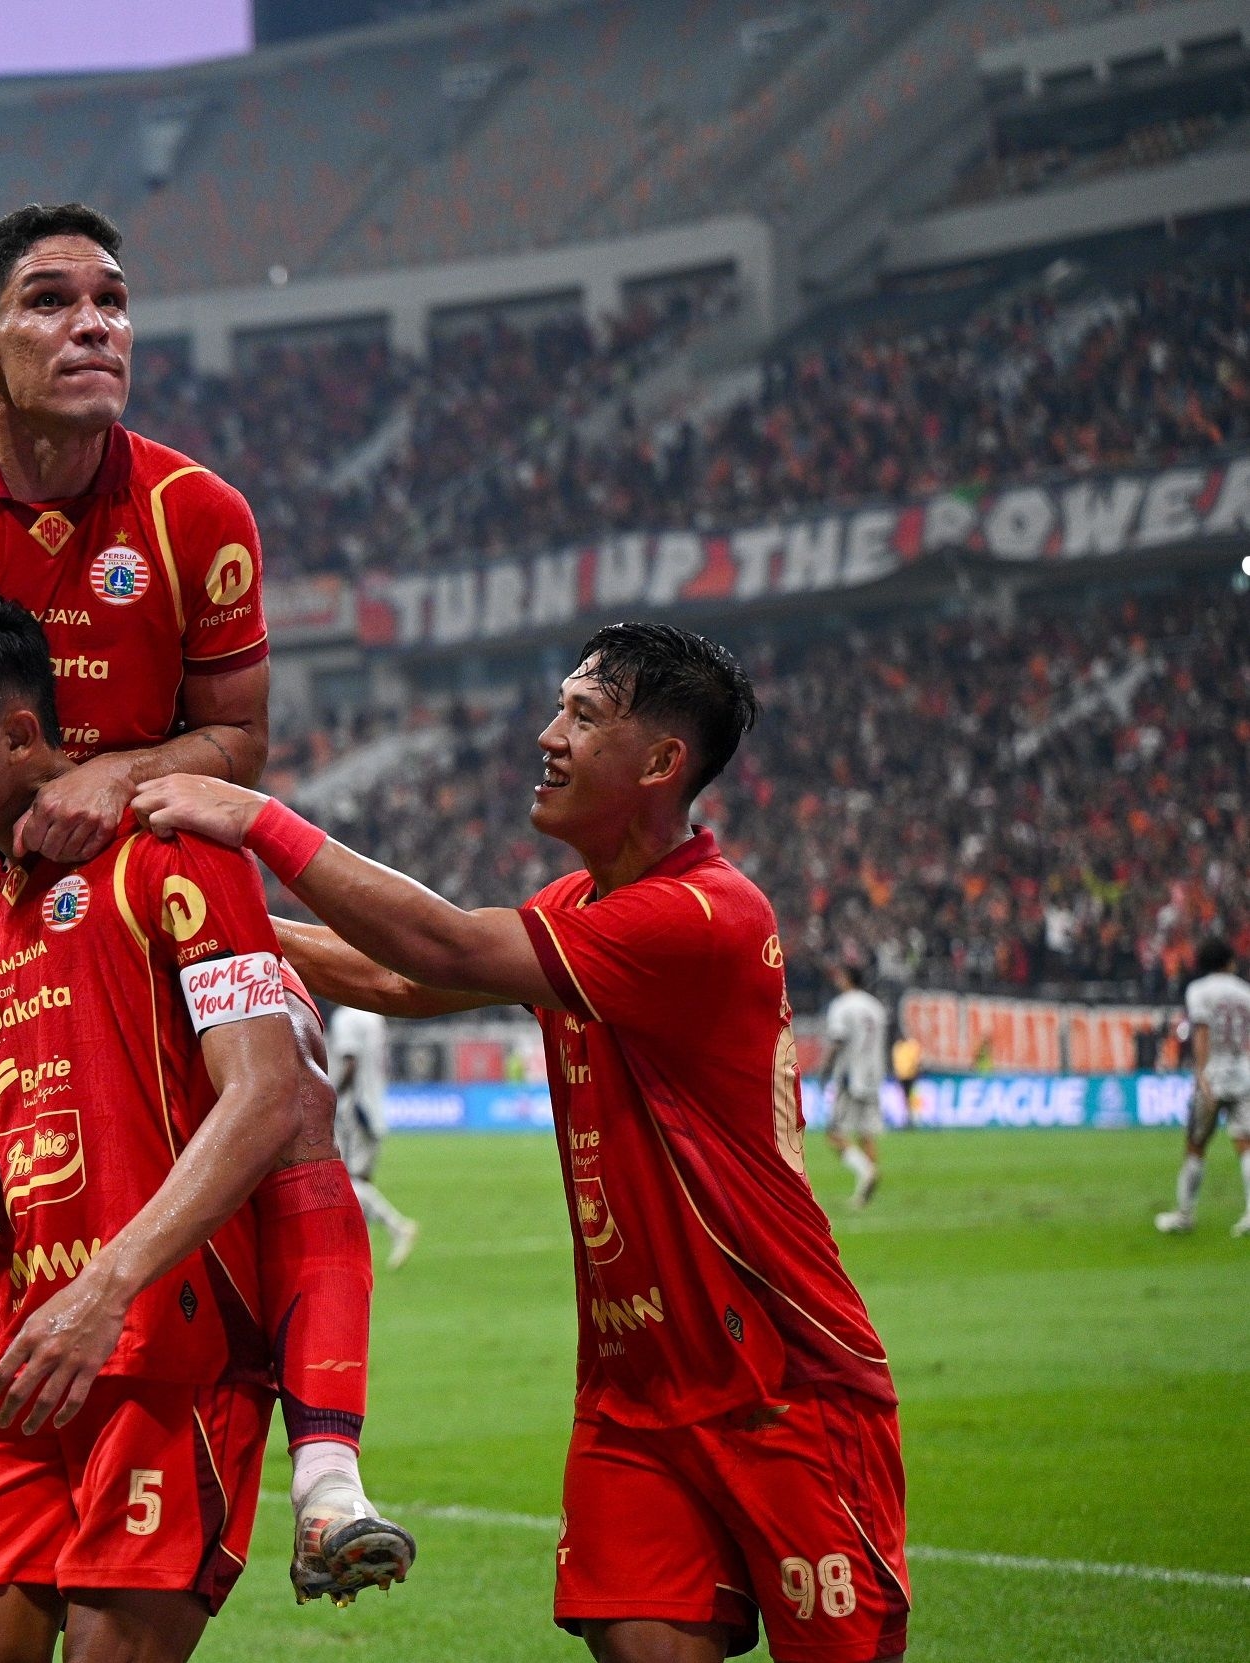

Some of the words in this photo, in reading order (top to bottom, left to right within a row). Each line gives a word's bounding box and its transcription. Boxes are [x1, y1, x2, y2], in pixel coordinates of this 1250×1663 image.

[103, 552, 137, 560] PERSIJA
[388, 558, 579, 648] TURN
[595, 533, 705, 606] UP
[731, 509, 899, 598] THE
[200, 604, 252, 628] netzme
[49, 655, 109, 680] arta
[188, 958, 255, 993] COME
[194, 992, 235, 1020] YOU
[952, 1077, 1086, 1129] LEAGUE
[570, 1125, 600, 1150] krie
[125, 1469, 164, 1536] 5
[780, 1552, 856, 1620] 98
